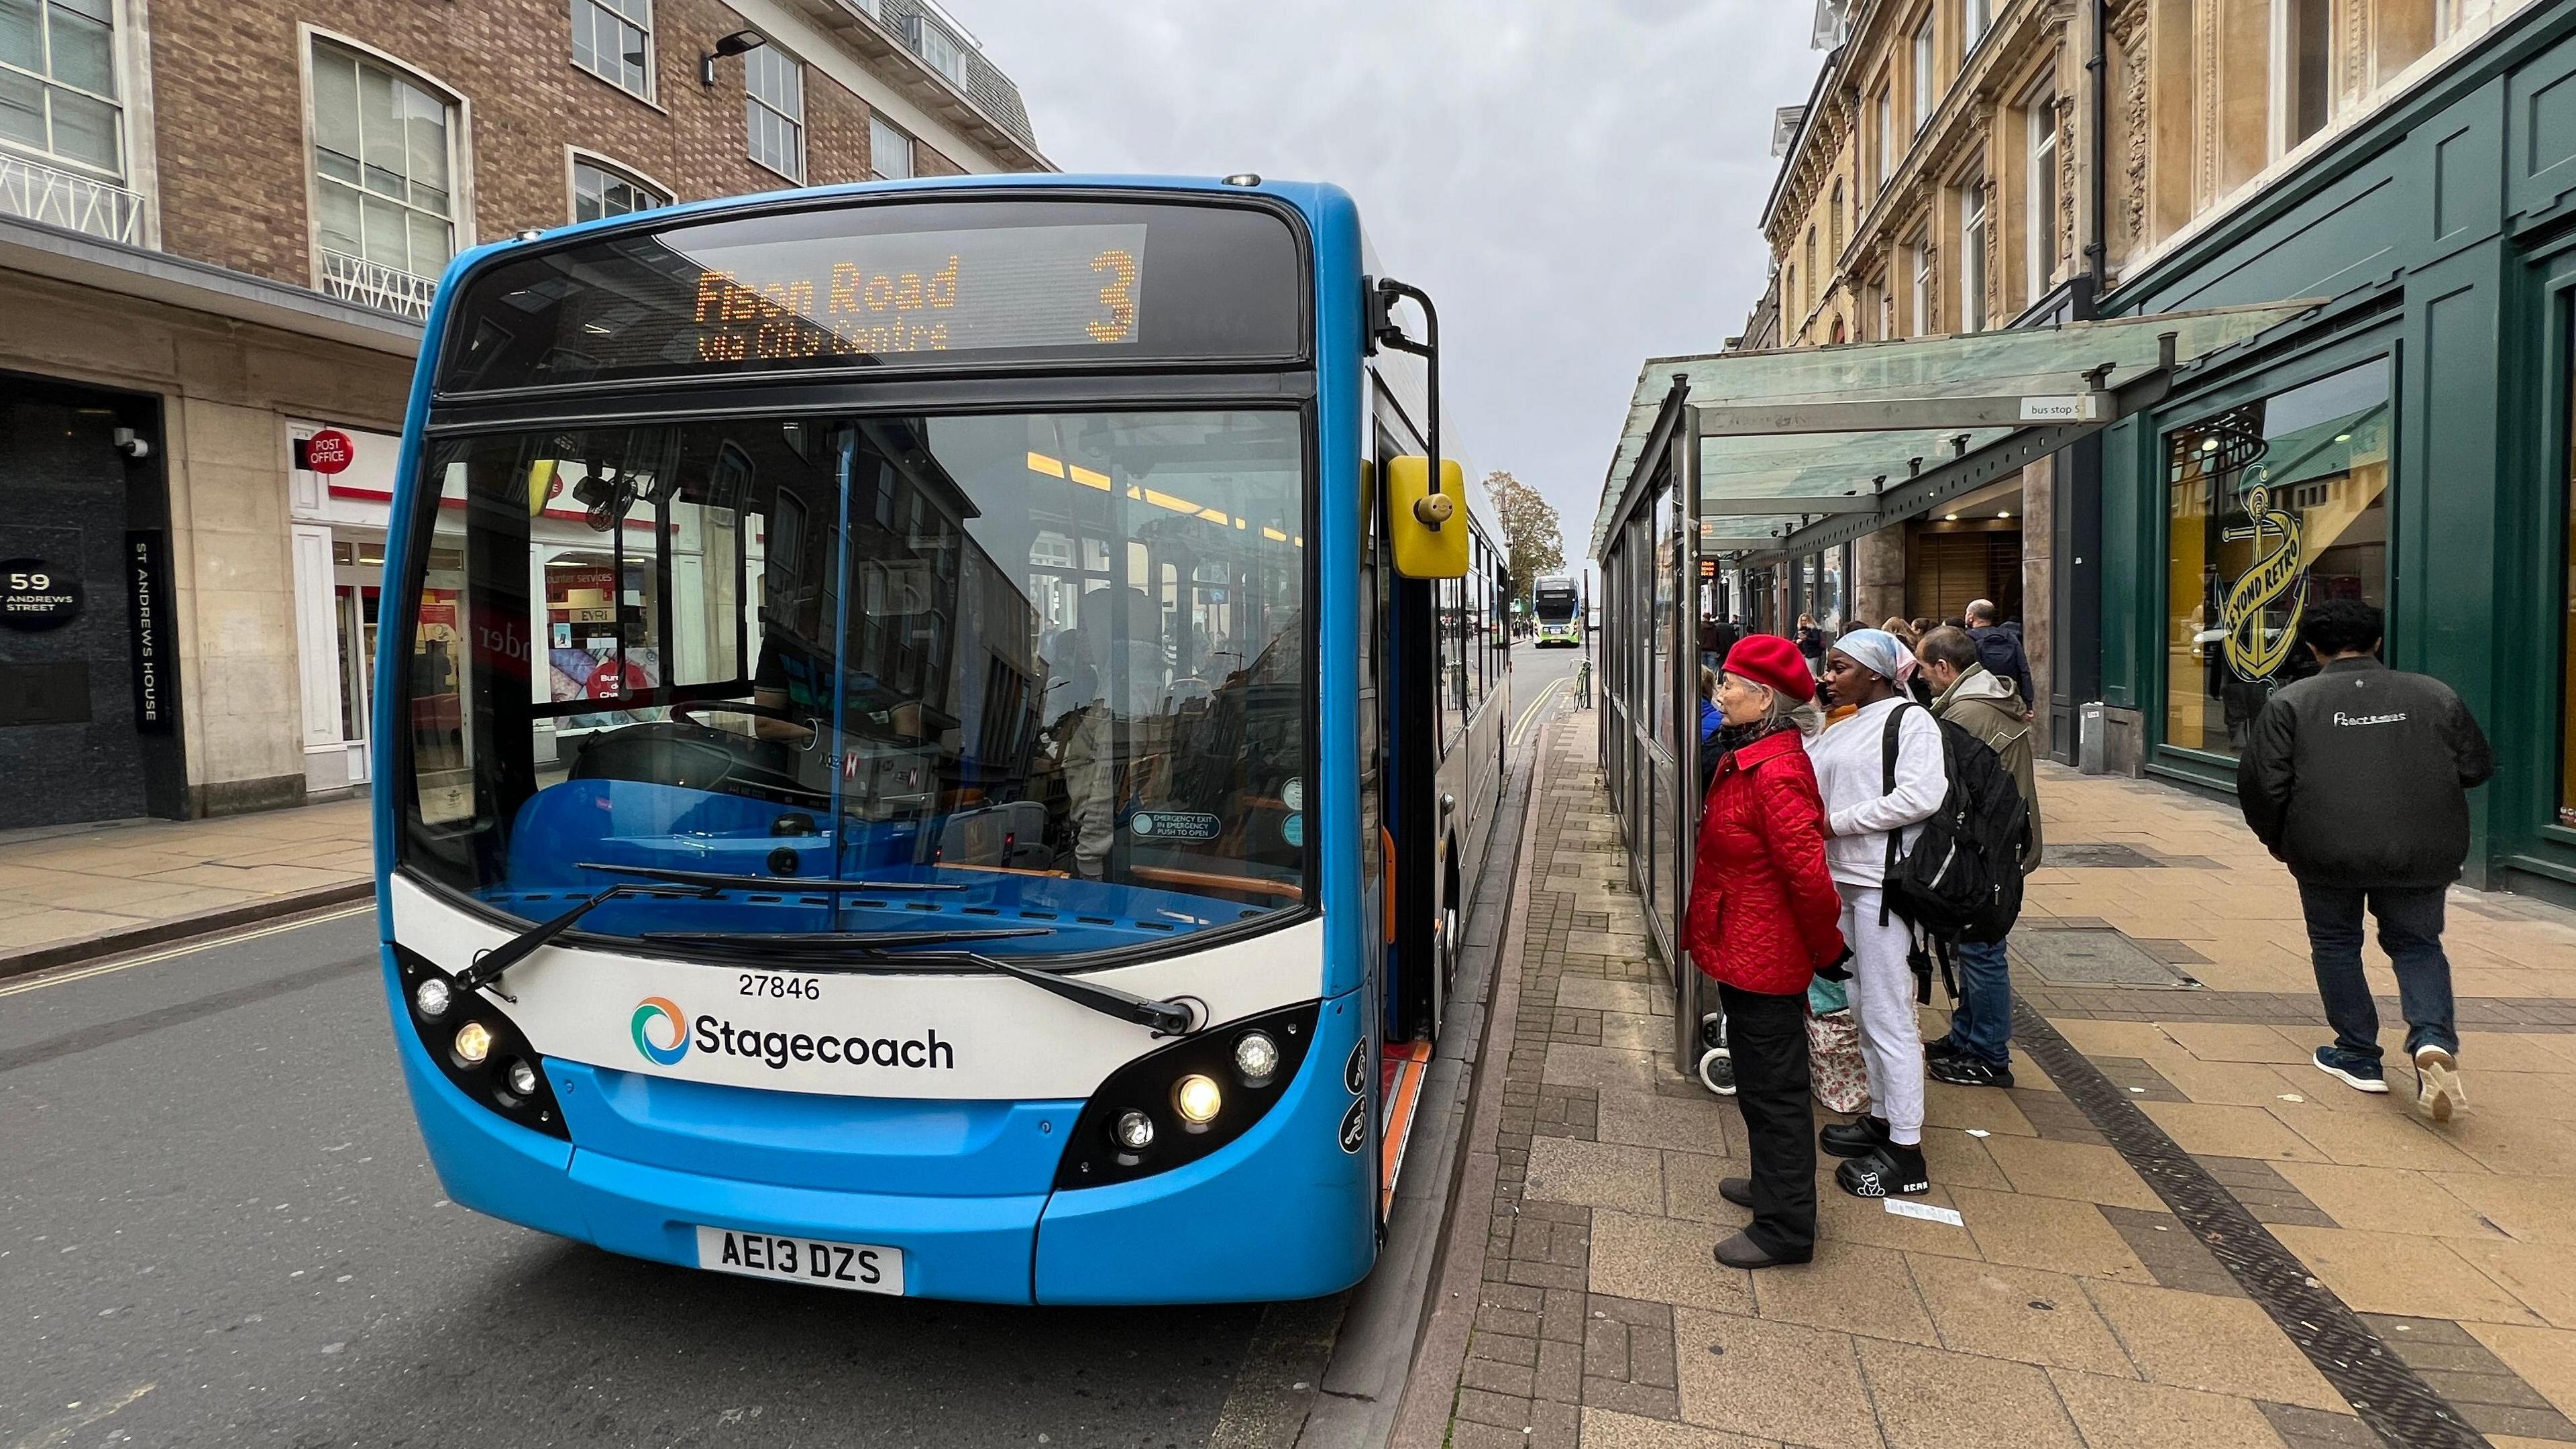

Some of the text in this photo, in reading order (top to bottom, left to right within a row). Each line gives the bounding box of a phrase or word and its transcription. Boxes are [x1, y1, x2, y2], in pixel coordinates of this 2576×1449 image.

[695, 254, 959, 323] Fison Road
[1085, 250, 1136, 342] 3
[698, 315, 948, 362] via City Centre
[2031, 405, 2048, 414] bus
[2051, 407, 2072, 416] stop
[315, 438, 341, 451] POST
[310, 450, 345, 464] OFFICE
[10, 573, 50, 590] 59
[577, 573, 612, 584] services
[2225, 539, 2298, 641] BEYOND RETRO
[6, 595, 73, 603] ANDREWS
[136, 542, 156, 720] ST ANDREWS HOUSE
[1153, 814, 1195, 822] EMERGENCY
[1157, 828, 1176, 836] PUSH
[1166, 822, 1209, 830] EMERGENCY
[739, 973, 820, 1000] 27846
[695, 1014, 954, 1070] Stagecoach
[1903, 1181, 1929, 1193] BEAR
[721, 1232, 881, 1285] AE13 DZS
